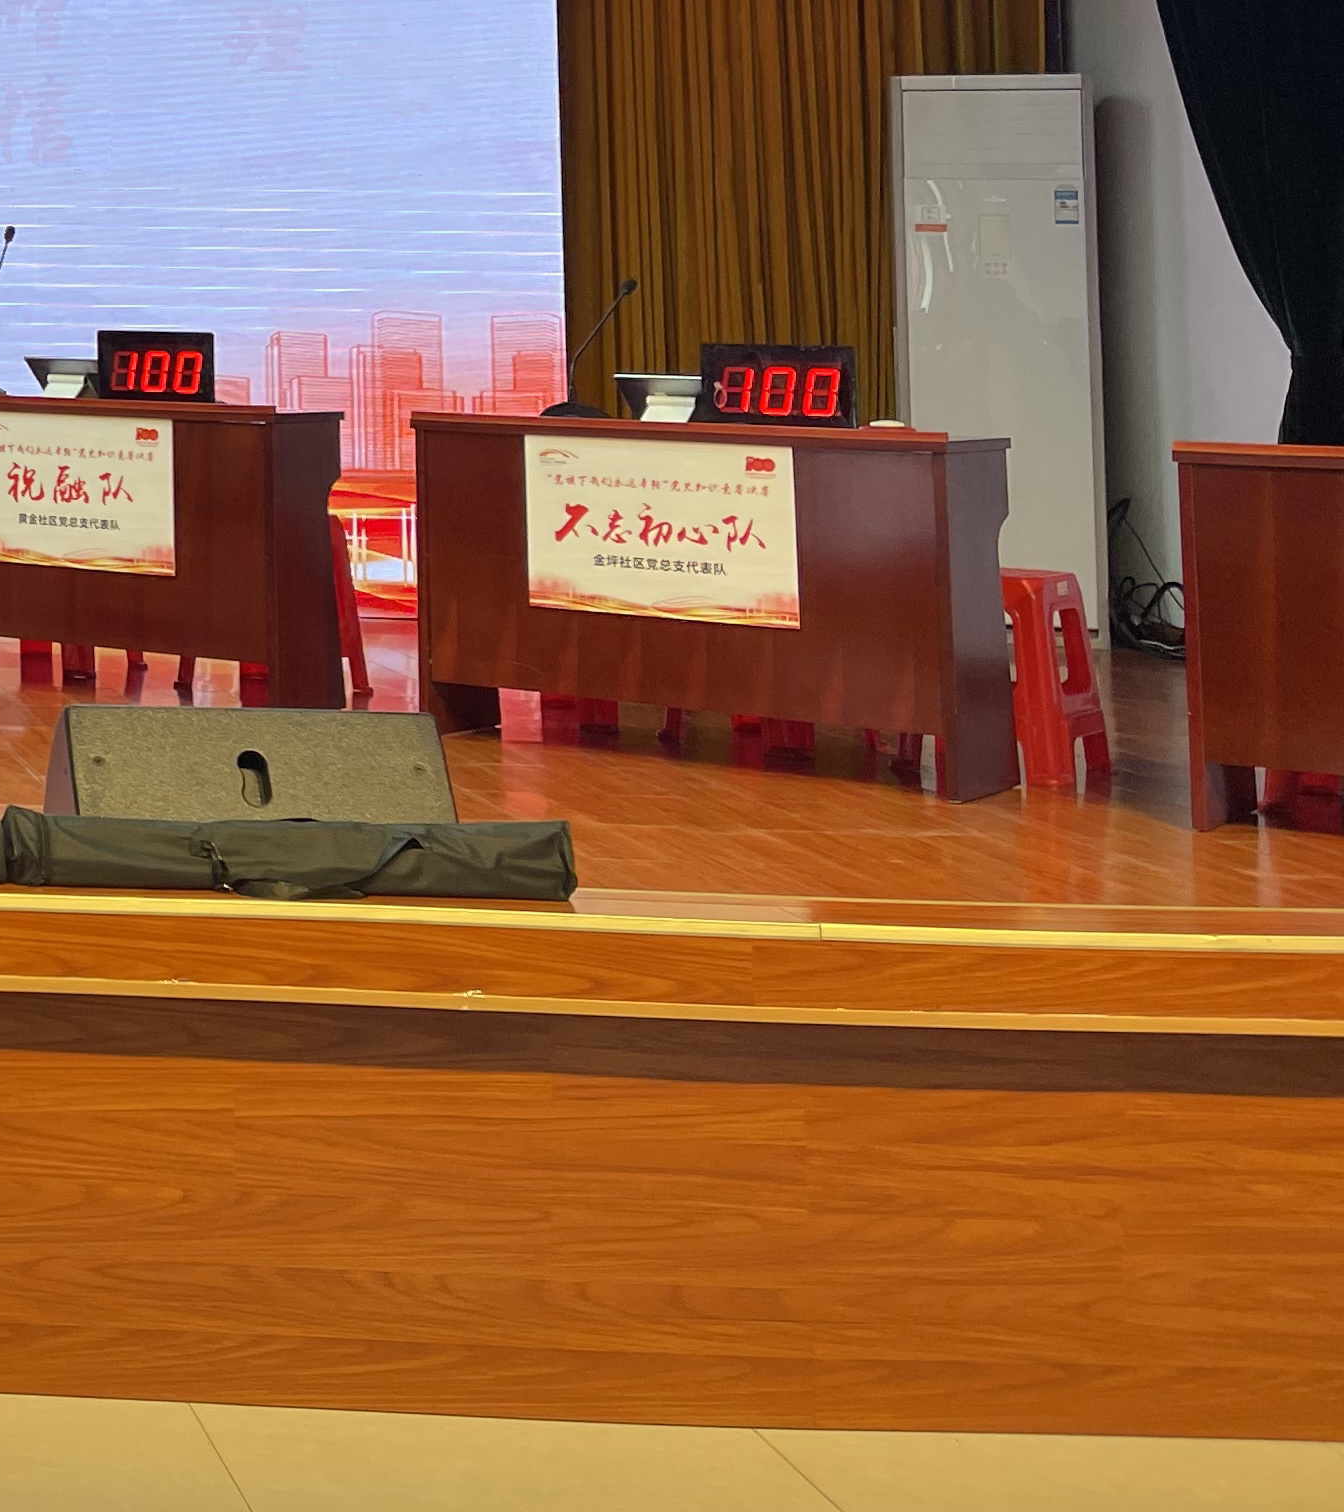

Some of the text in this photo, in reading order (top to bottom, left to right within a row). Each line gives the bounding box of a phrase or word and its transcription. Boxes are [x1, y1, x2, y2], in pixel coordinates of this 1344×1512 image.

[112, 349, 204, 395] 100
[720, 366, 841, 418] 100
[6, 461, 134, 506] 祝融队
[553, 502, 768, 552] 不忘初心队
[592, 553, 728, 577] 金坪社区党总支代表队
